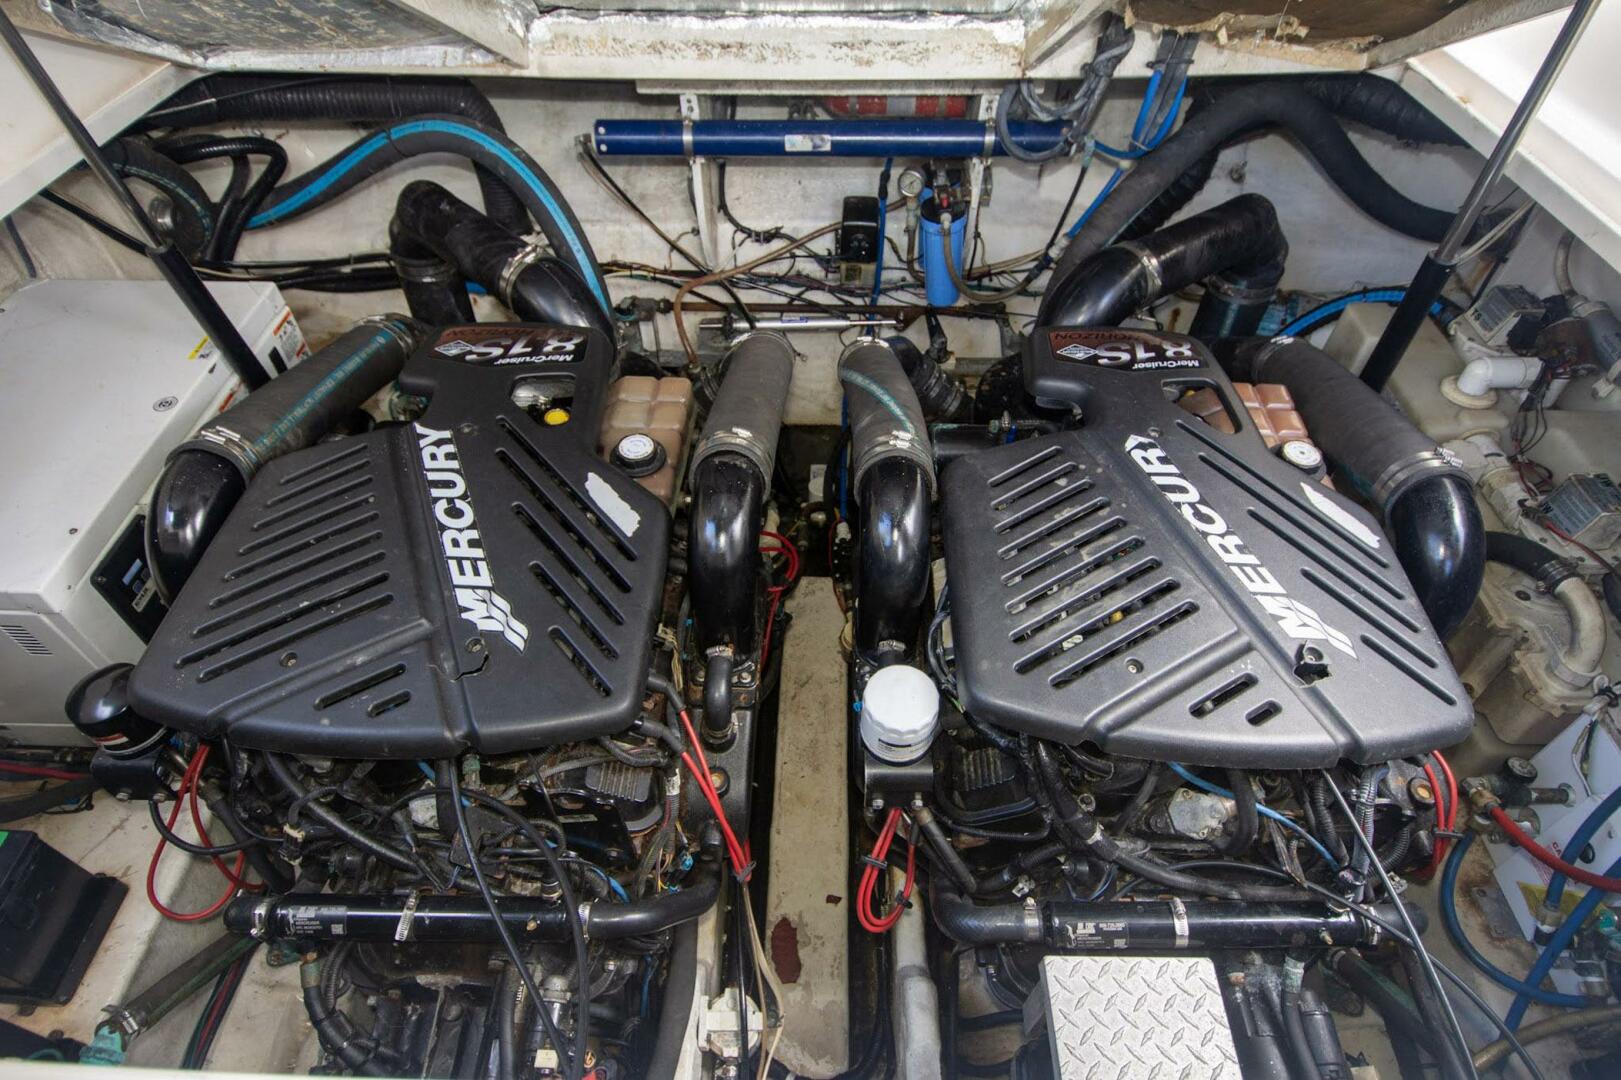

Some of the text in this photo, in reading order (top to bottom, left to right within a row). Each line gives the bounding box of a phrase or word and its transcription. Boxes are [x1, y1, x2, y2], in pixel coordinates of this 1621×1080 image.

[494, 354, 574, 366] MerCruiser
[1132, 359, 1200, 370] MerCruiser
[413, 423, 522, 646] MERCURY
